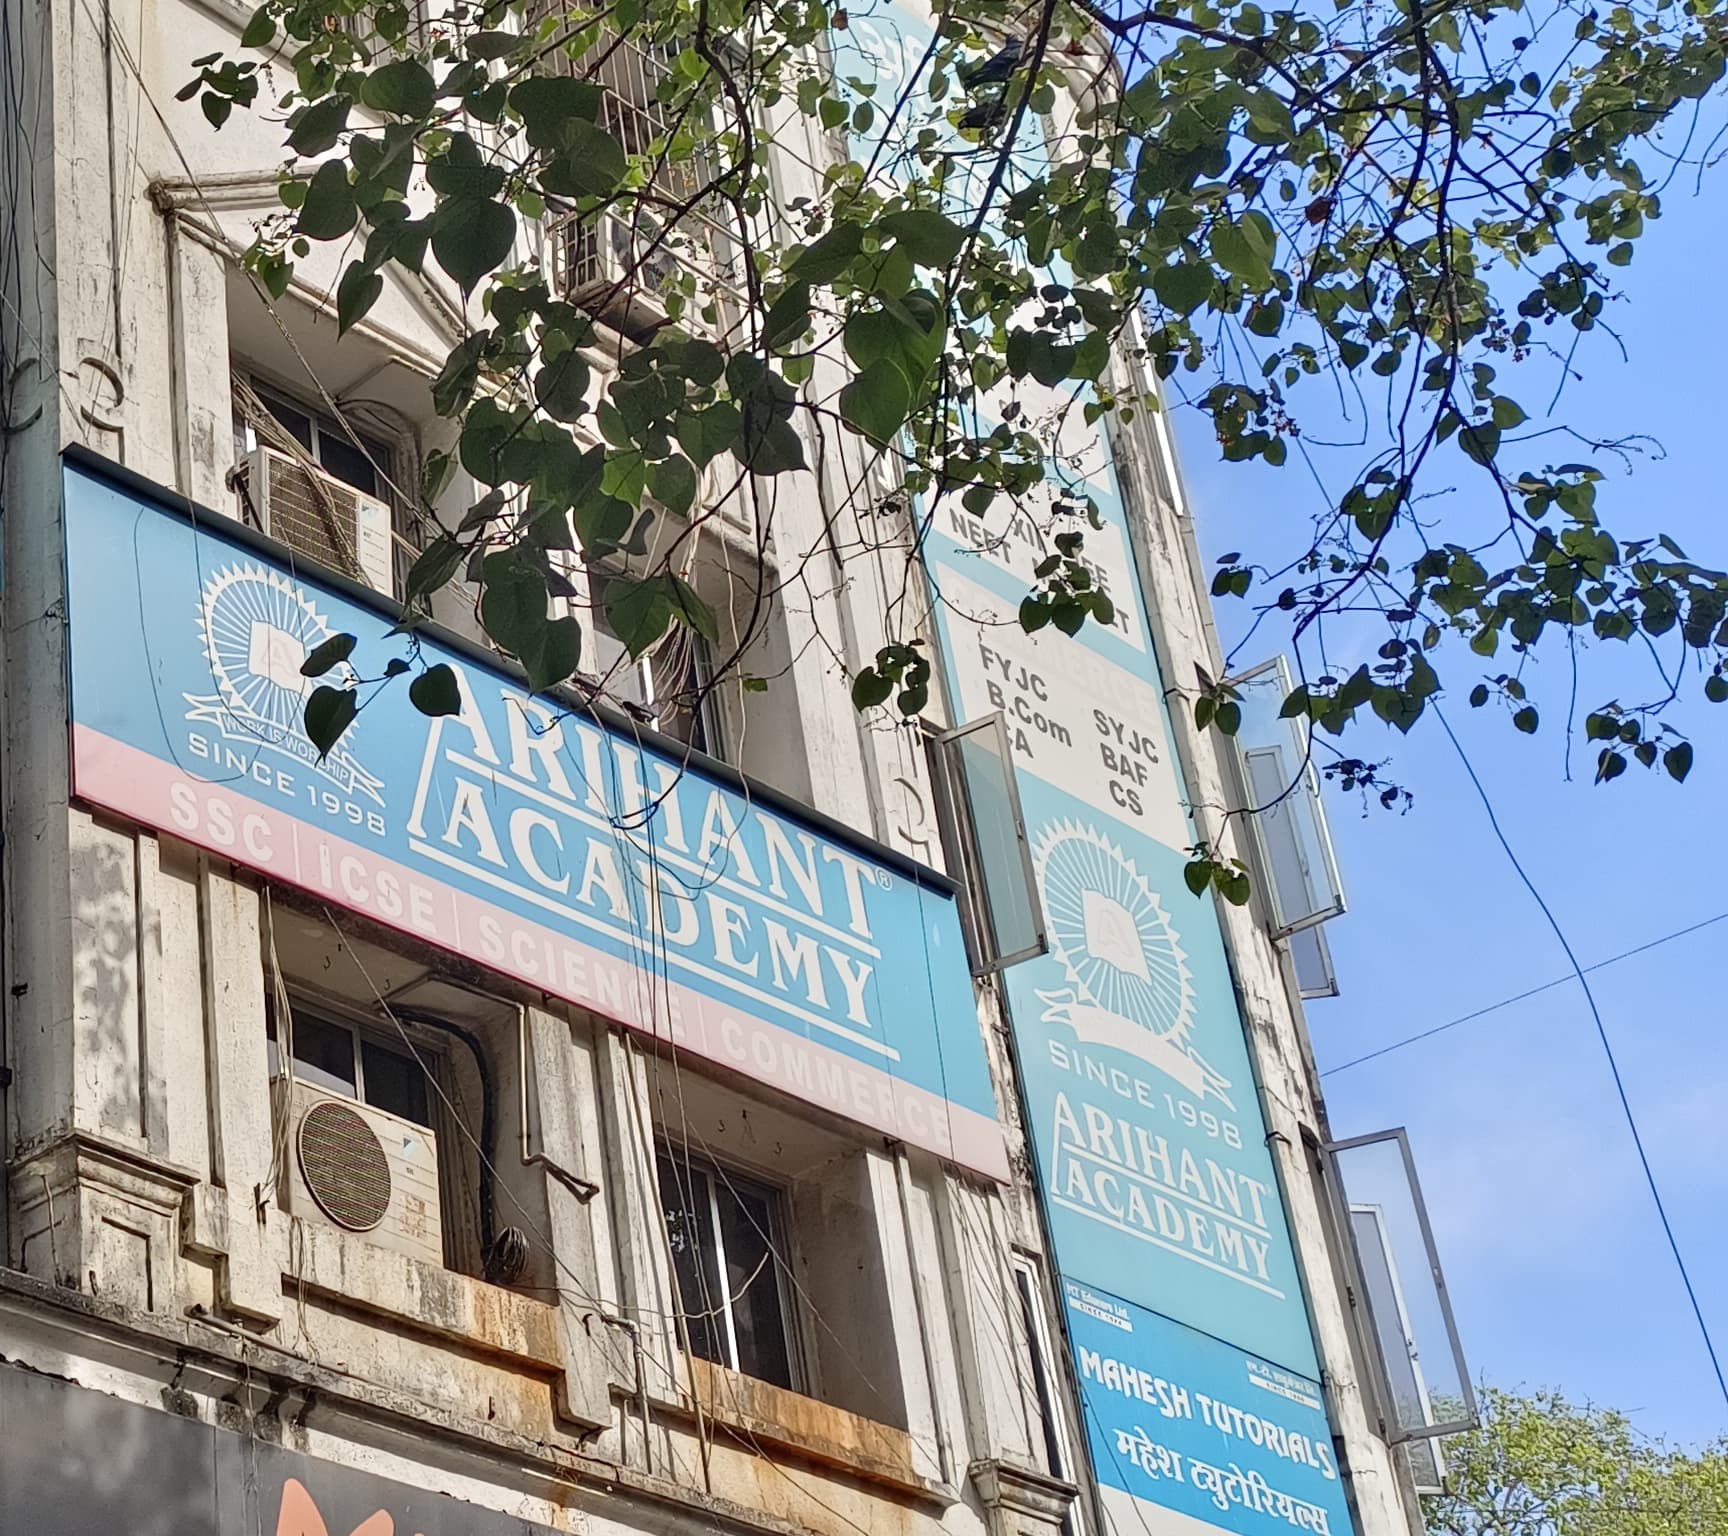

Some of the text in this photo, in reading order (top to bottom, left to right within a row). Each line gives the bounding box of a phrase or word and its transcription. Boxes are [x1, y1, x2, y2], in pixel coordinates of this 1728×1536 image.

[986, 678, 1073, 748] B.Com
[1099, 743, 1148, 788] BAF
[187, 732, 387, 838] SINCE 1998
[412, 662, 877, 941] ARIHANT
[1108, 779, 1144, 817] CS
[442, 776, 873, 1029] ACADEMY
[169, 781, 951, 1144] SSC ICSE SCIENCE COMMERCE
[1047, 1038, 1244, 1151] SINCE 1998
[1051, 1091, 1271, 1229] ARIHANT
[1064, 1157, 1271, 1281] ACADEMY
[1078, 1344, 1192, 1420] MAHESH
[1195, 1392, 1337, 1481] TUTORIALS
[1112, 1424, 1185, 1483] महेश
